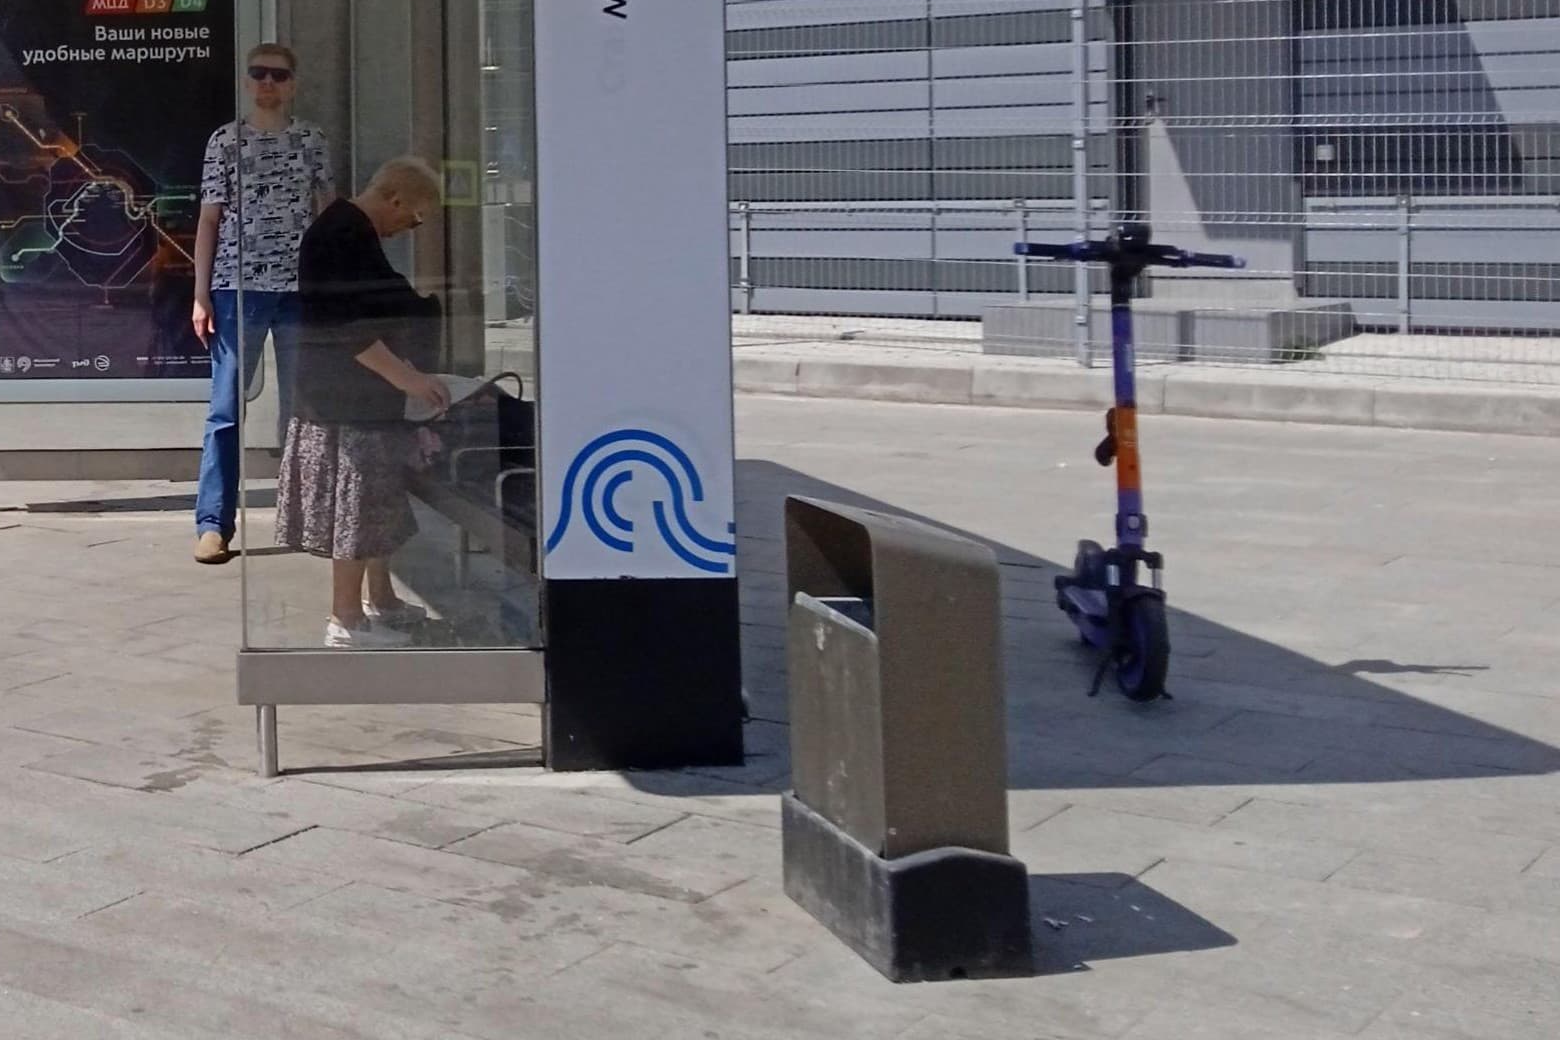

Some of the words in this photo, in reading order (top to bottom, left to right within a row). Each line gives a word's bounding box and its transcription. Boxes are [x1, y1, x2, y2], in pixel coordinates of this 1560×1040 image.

[95, 25, 145, 41] Ваши
[151, 26, 210, 40] новые
[23, 45, 106, 65] удобные
[111, 46, 210, 63] маршруты
